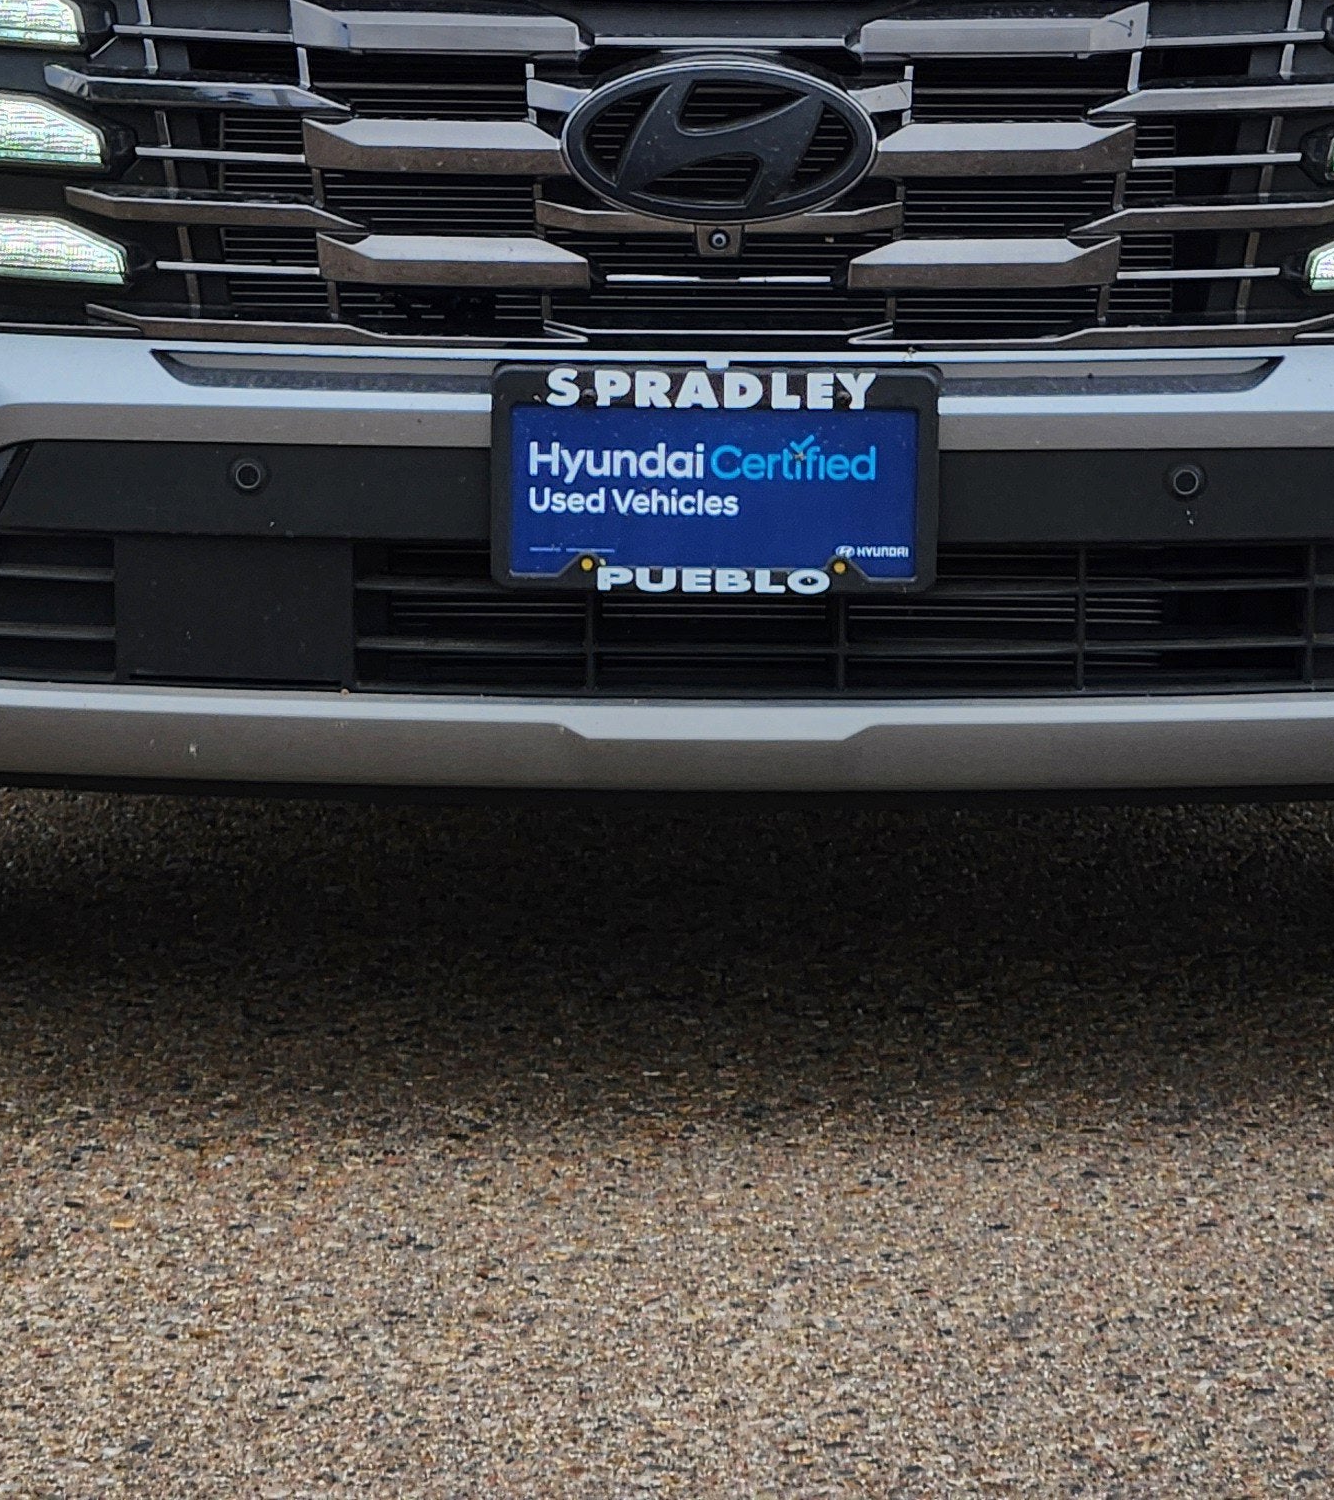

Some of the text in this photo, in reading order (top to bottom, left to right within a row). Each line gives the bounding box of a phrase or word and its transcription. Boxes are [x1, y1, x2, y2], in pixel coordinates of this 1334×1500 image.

[546, 368, 876, 410] SPRADLEY
[529, 434, 876, 484] Hyundai Certified
[529, 486, 740, 517] Used Vehicles
[856, 545, 909, 558] HYUNDAI
[597, 567, 830, 594] PUEBLO
